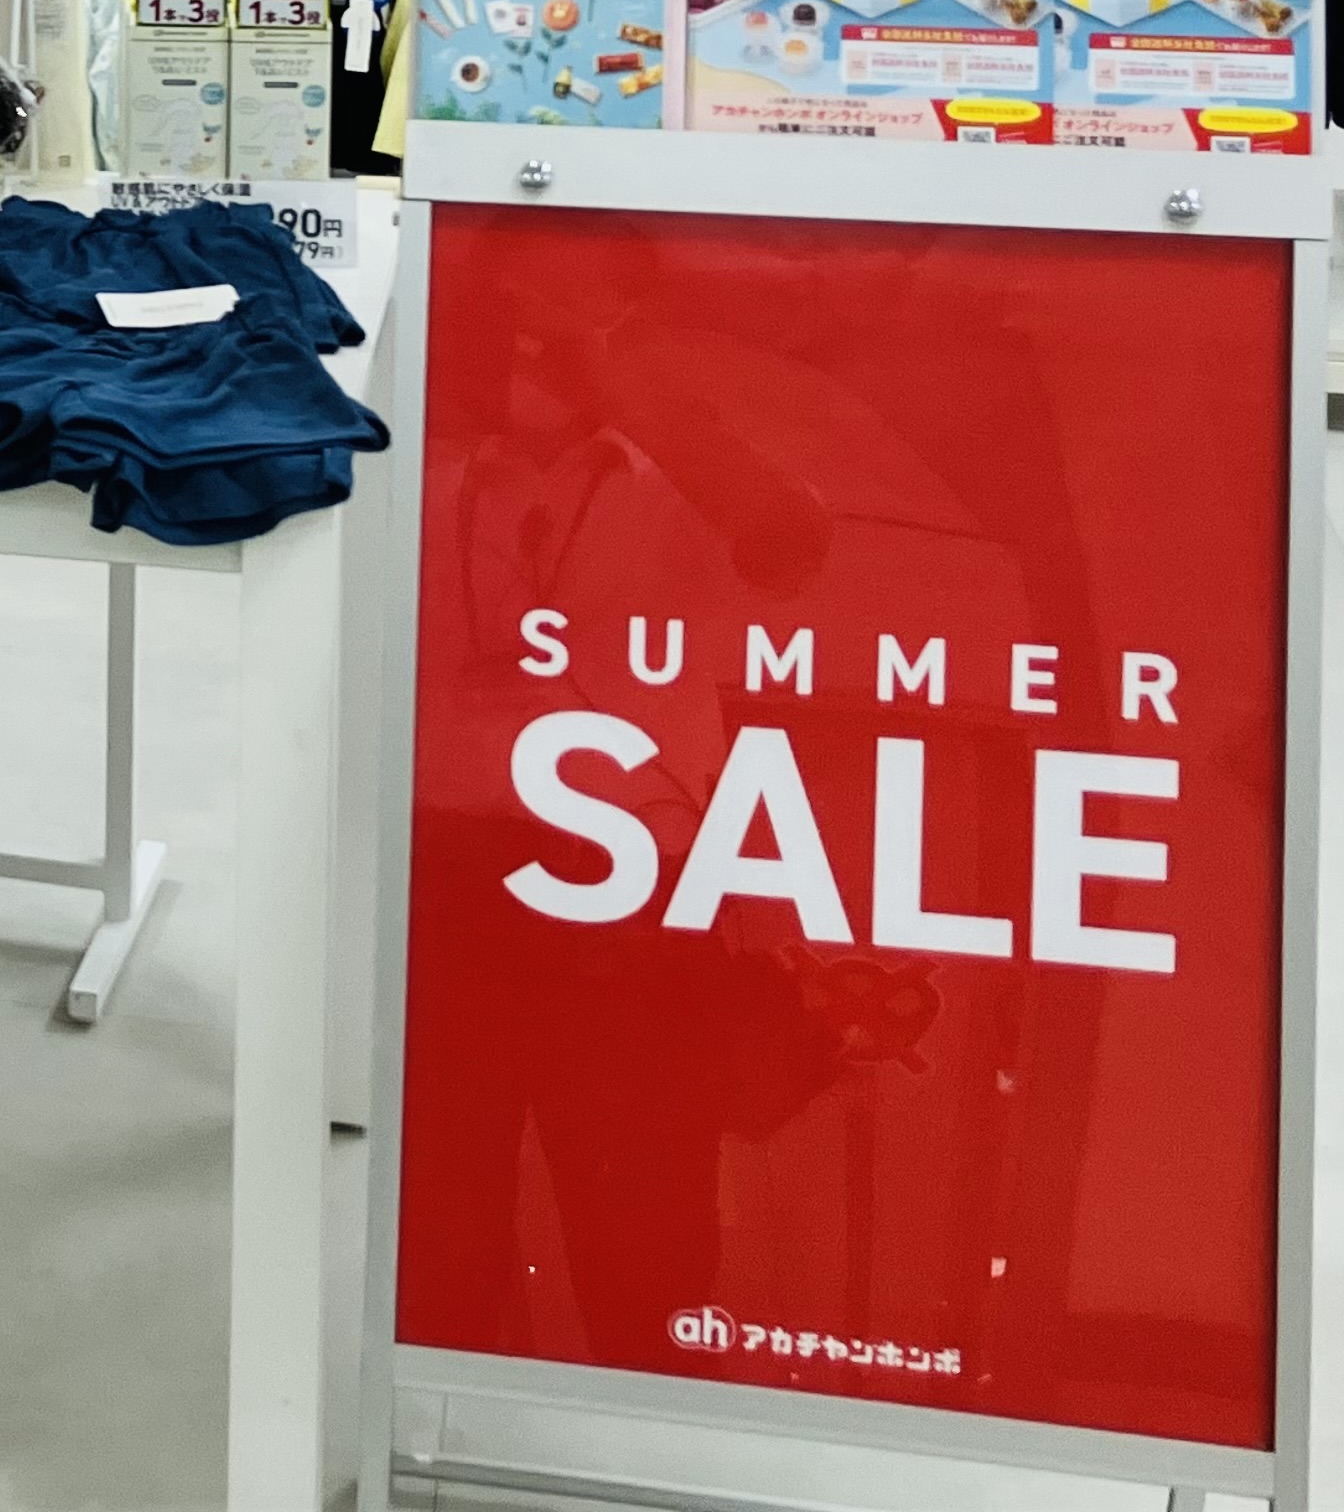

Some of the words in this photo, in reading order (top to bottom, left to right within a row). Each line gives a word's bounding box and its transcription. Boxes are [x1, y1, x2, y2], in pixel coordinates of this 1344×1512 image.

[518, 608, 1179, 725] SUMMER
[502, 708, 1180, 975] SALE
[673, 1306, 730, 1349] ah
[741, 1323, 962, 1375] アカチャンホンポ
